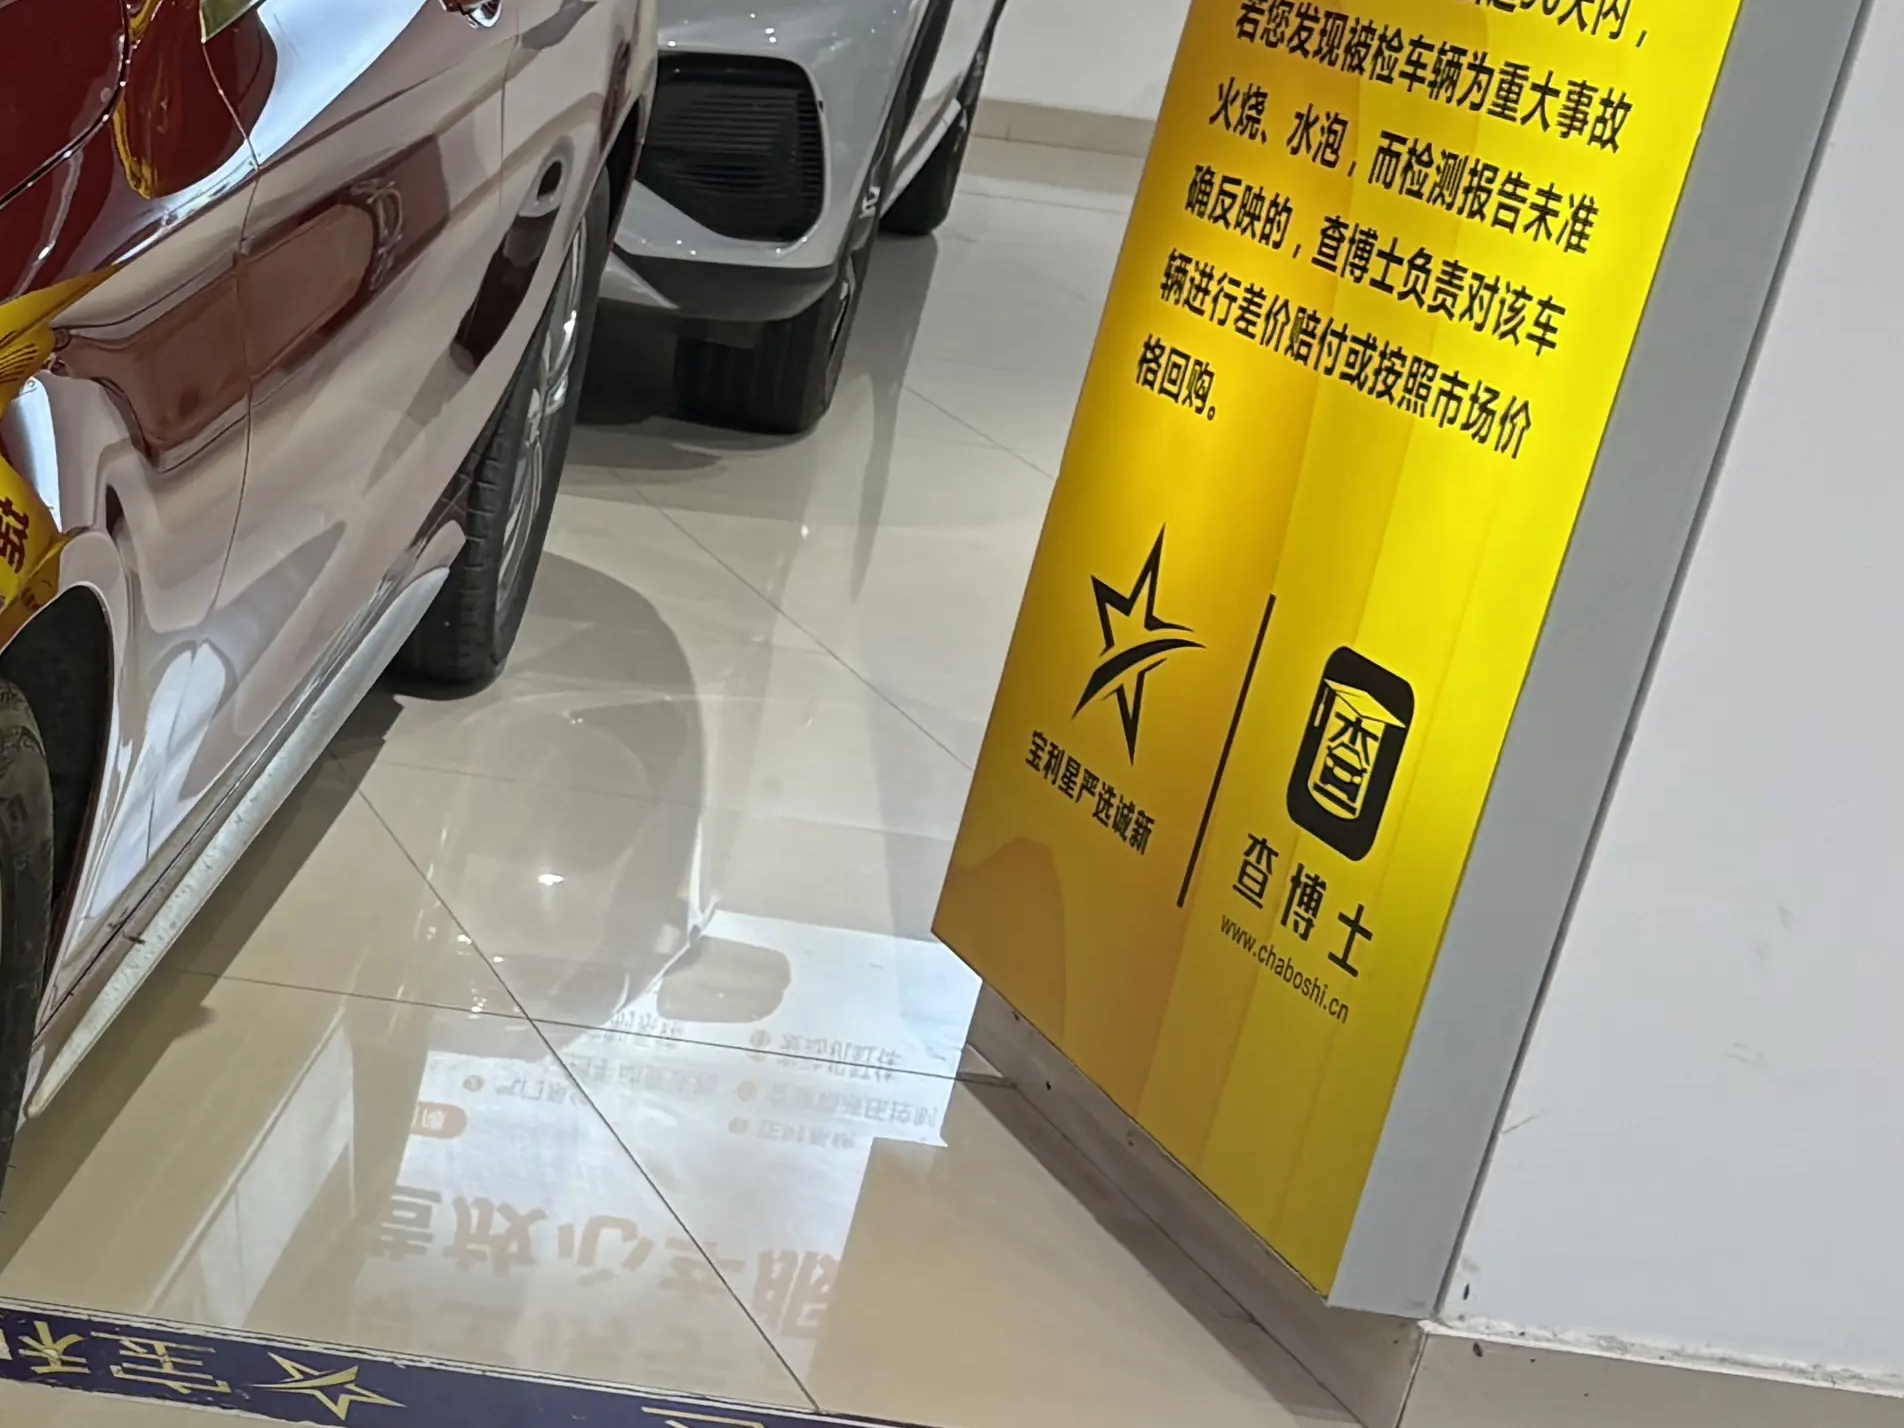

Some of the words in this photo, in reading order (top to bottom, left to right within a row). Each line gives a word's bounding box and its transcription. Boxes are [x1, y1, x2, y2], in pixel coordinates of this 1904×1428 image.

[1134, 334, 1220, 424] 格回购。
[1157, 246, 1533, 461] 辆进行差价赔付或按照市场价
[1220, 914, 1350, 1025] www.chaboshi.cn
[1232, 832, 1374, 979] 查博士
